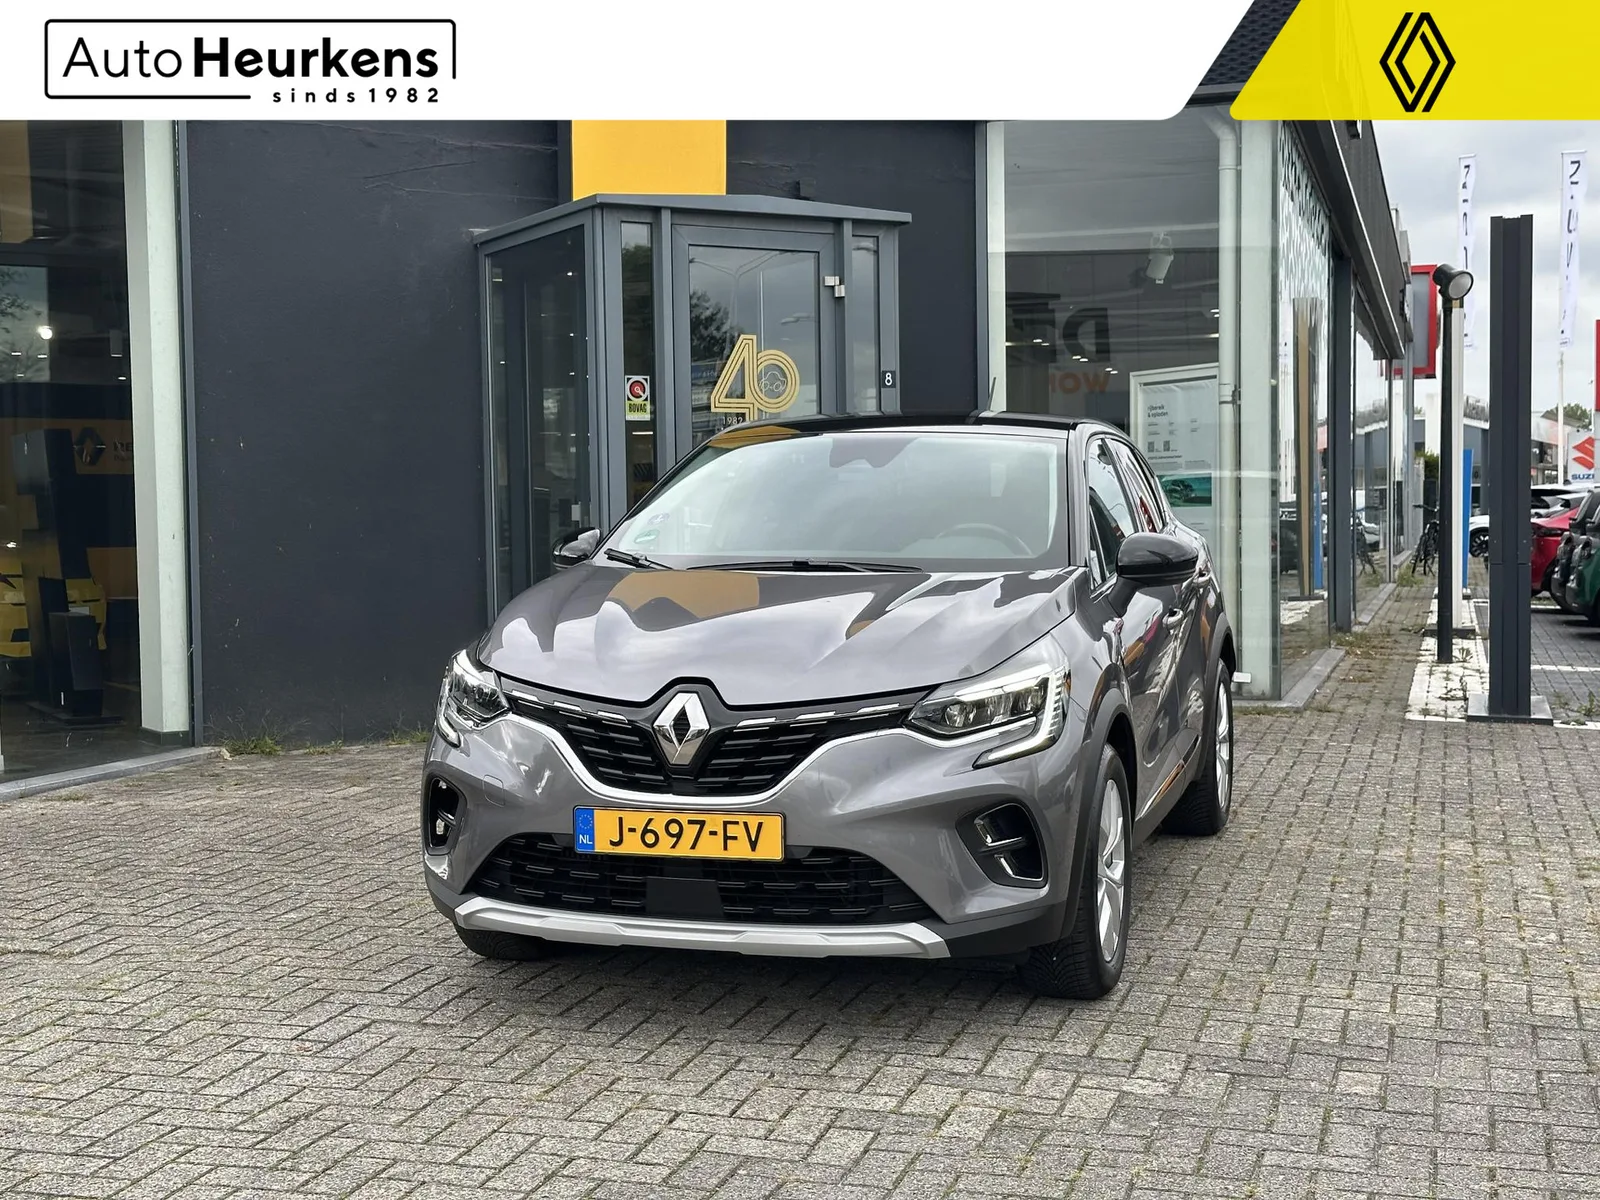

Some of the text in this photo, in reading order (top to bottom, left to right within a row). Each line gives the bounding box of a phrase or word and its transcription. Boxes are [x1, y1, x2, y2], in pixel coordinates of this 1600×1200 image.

[711, 334, 800, 421] 40
[884, 372, 893, 386] 8
[628, 403, 647, 413] BOVAG
[579, 834, 593, 844] NL
[609, 816, 764, 852] J-697-FV
